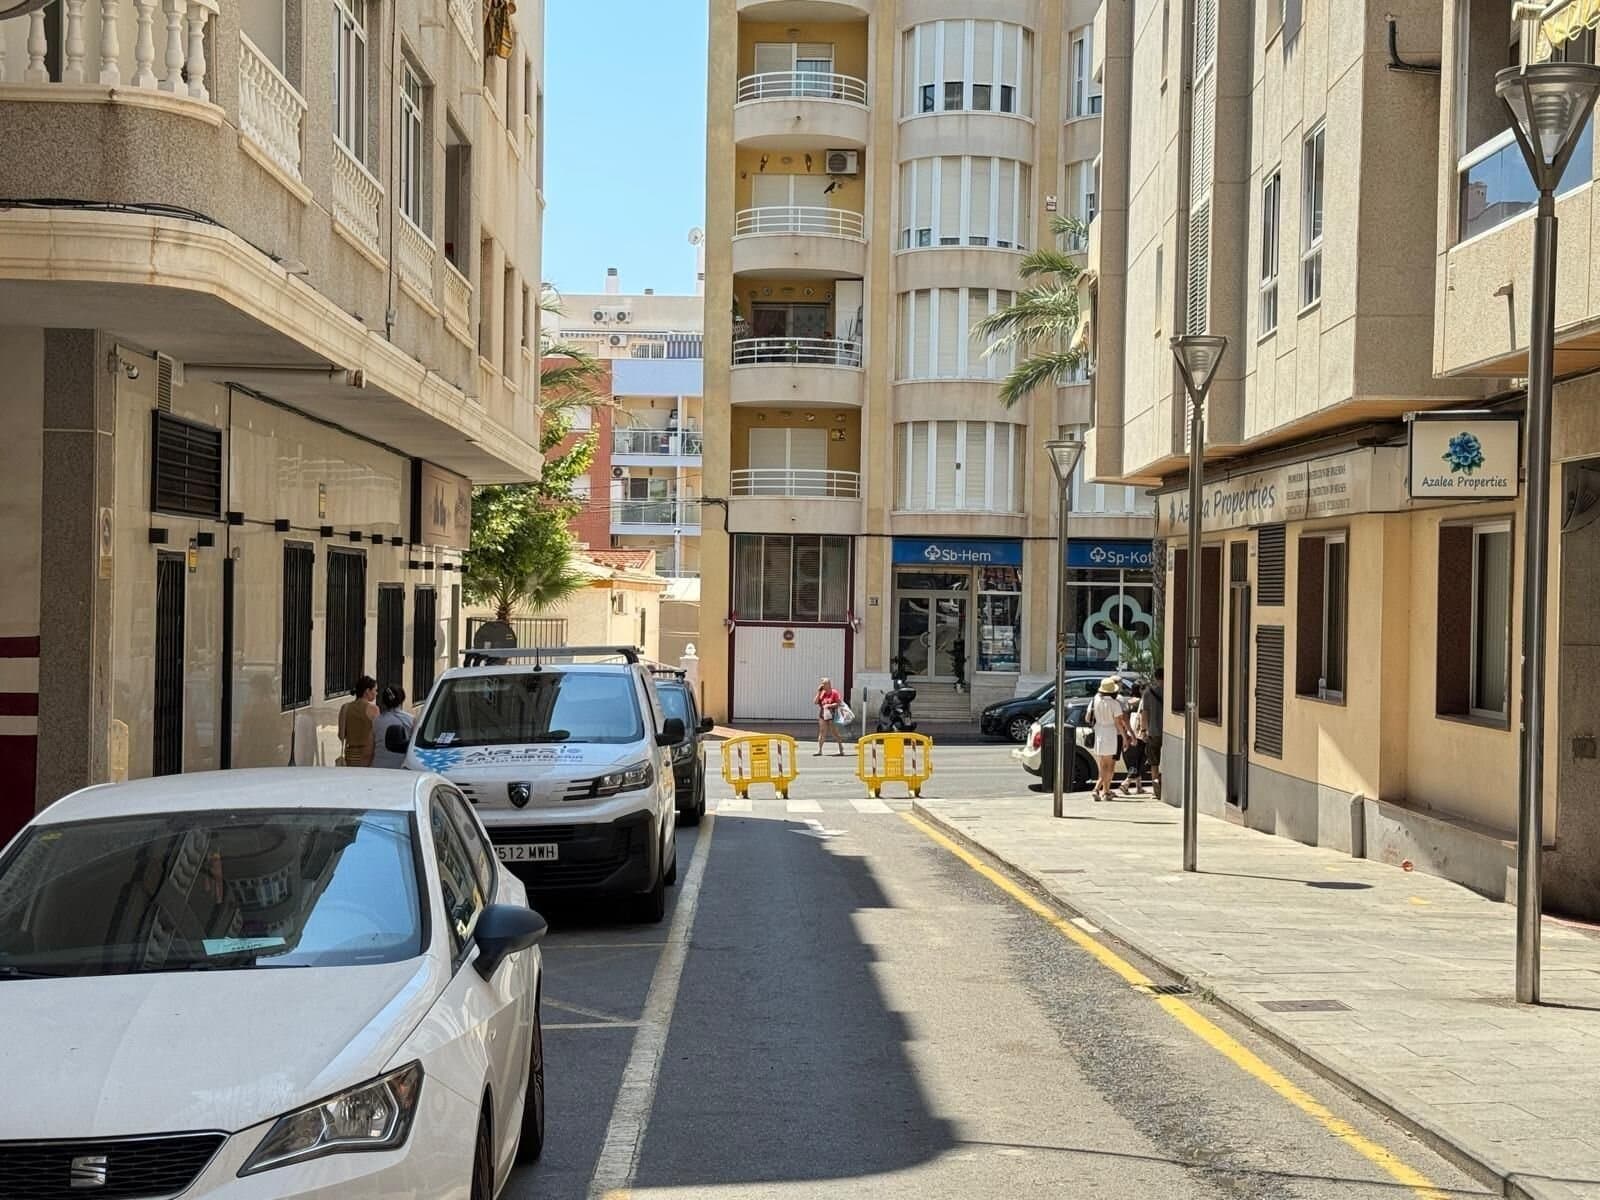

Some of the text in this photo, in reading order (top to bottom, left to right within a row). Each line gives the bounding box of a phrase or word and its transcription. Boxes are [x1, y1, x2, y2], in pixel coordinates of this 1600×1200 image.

[1422, 475, 1507, 491] Azalea Properties
[1213, 478, 1275, 526] Properties
[942, 549, 992, 562] Sb-Hem
[528, 845, 555, 859] MWH
